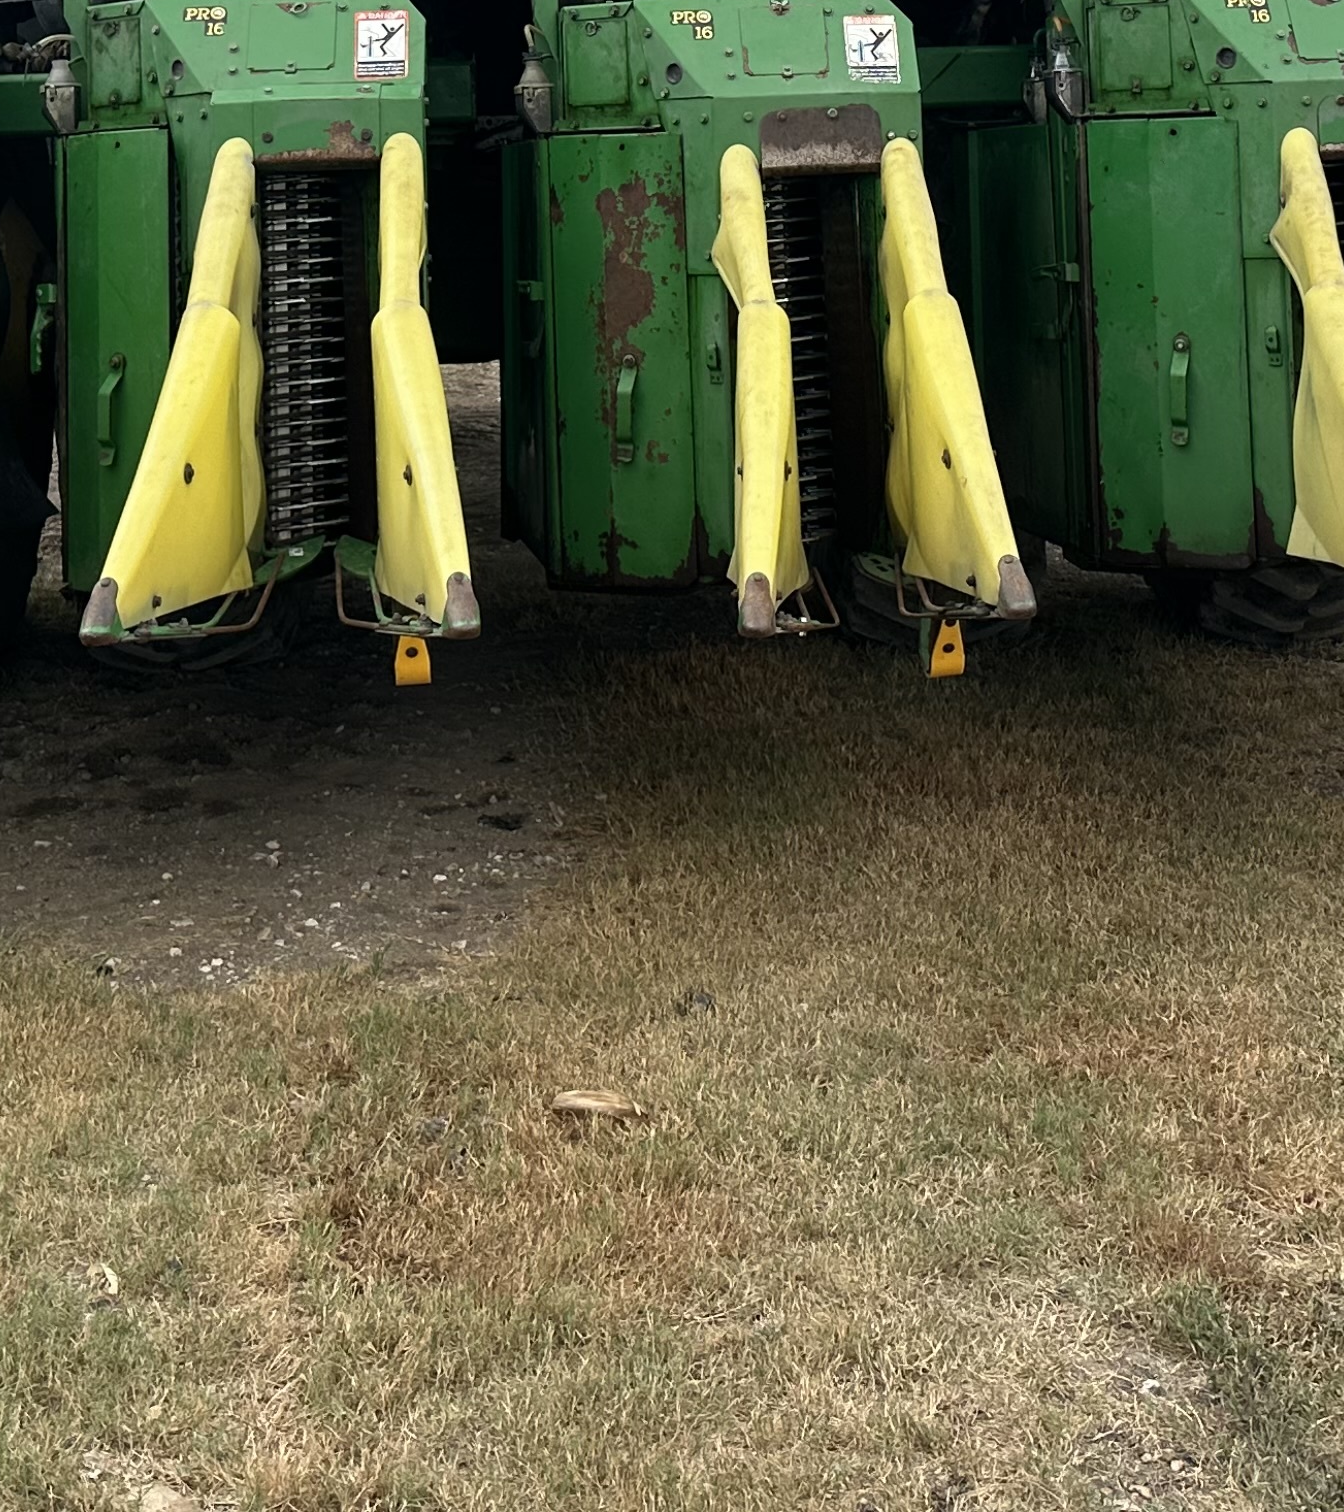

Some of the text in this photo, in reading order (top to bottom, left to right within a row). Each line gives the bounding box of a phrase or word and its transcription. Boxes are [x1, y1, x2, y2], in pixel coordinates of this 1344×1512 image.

[185, 6, 227, 21] PRO
[671, 10, 712, 25] PRO
[1251, 9, 1271, 23] 16
[206, 22, 225, 36] 16
[695, 25, 714, 39] 16
